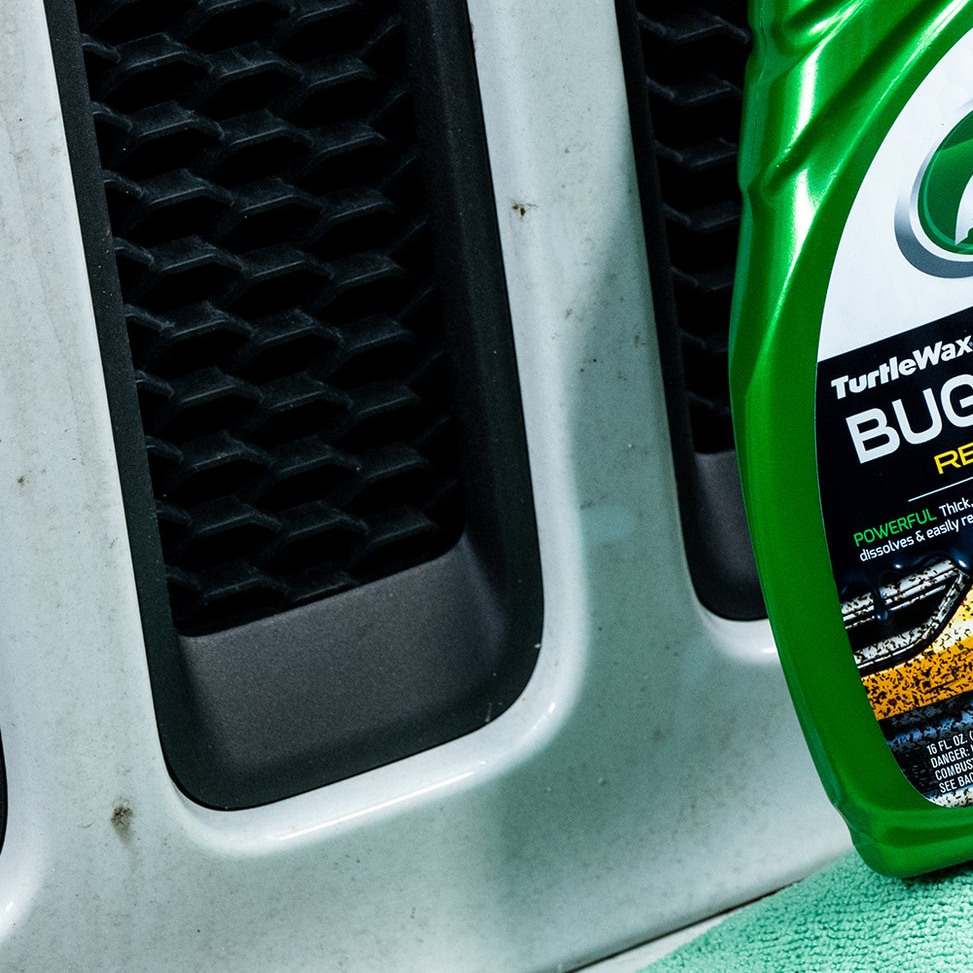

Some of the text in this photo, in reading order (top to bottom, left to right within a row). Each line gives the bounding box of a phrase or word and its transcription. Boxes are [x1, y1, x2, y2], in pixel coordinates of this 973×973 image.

[853, 509, 937, 547] POWERFUL
[939, 497, 973, 517] Thick,
[860, 535, 914, 562] dissolves
[915, 531, 926, 542] &
[926, 519, 959, 538] easily
[927, 743, 937, 755] 16
[953, 734, 968, 747] OZ.
[930, 747, 970, 768] DANGER:
[939, 779, 957, 793] SEE
